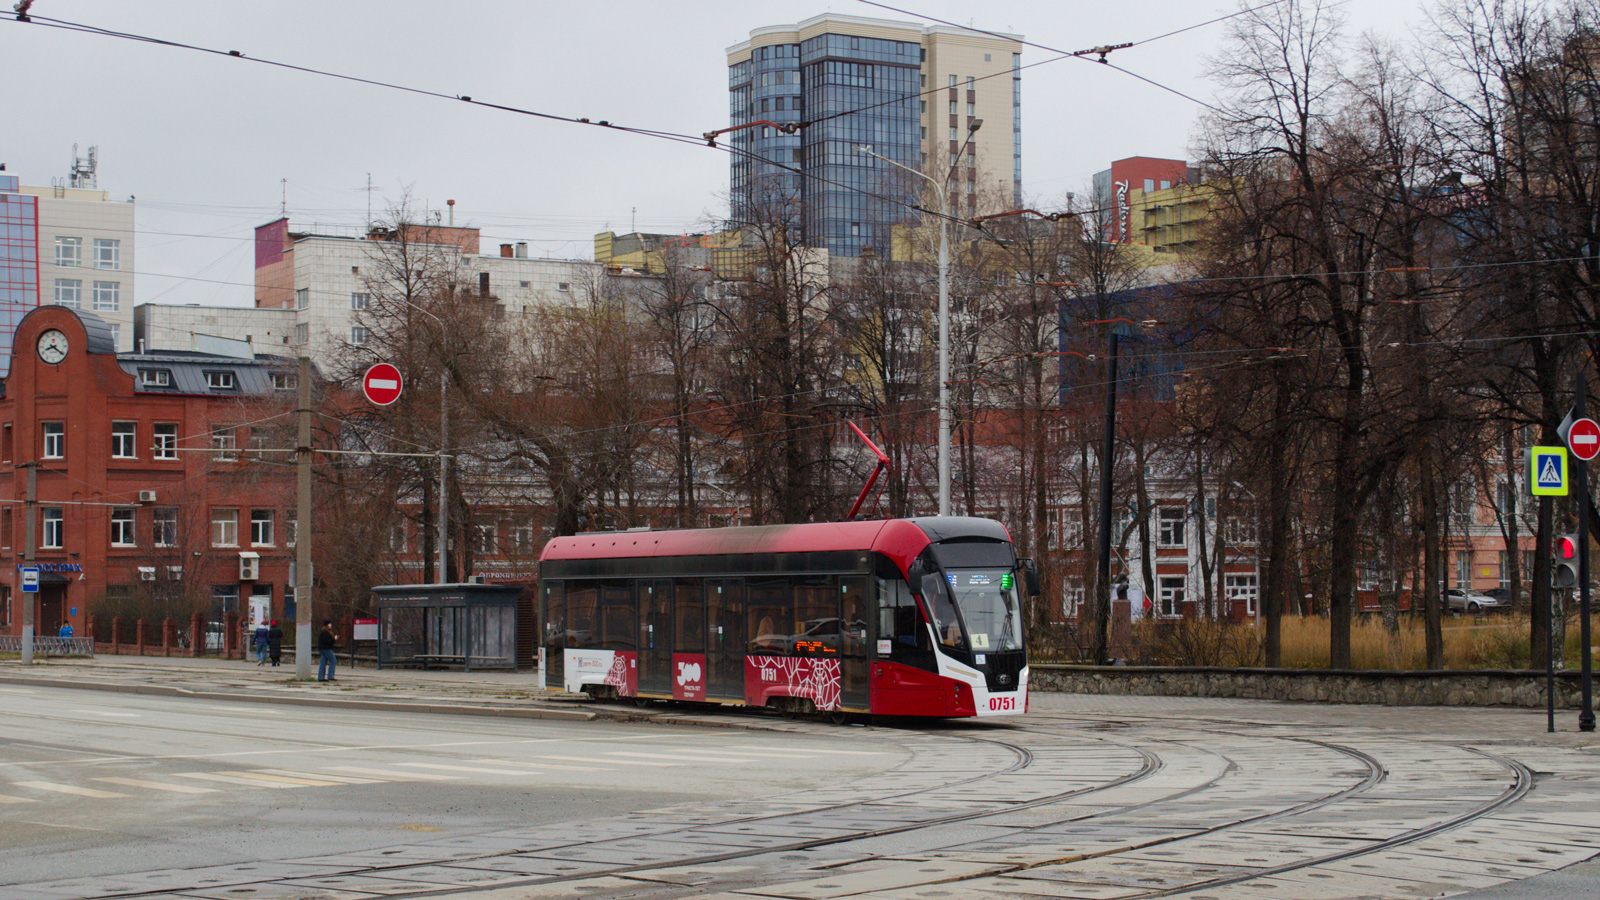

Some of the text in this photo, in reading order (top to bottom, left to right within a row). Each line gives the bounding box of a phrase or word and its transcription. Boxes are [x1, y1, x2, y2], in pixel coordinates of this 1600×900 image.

[1115, 179, 1130, 243] Radisson
[16, 563, 83, 572] ИОССТРАХ
[975, 635, 983, 646] 4
[761, 668, 777, 681] 0751
[989, 697, 1015, 711] 0751
